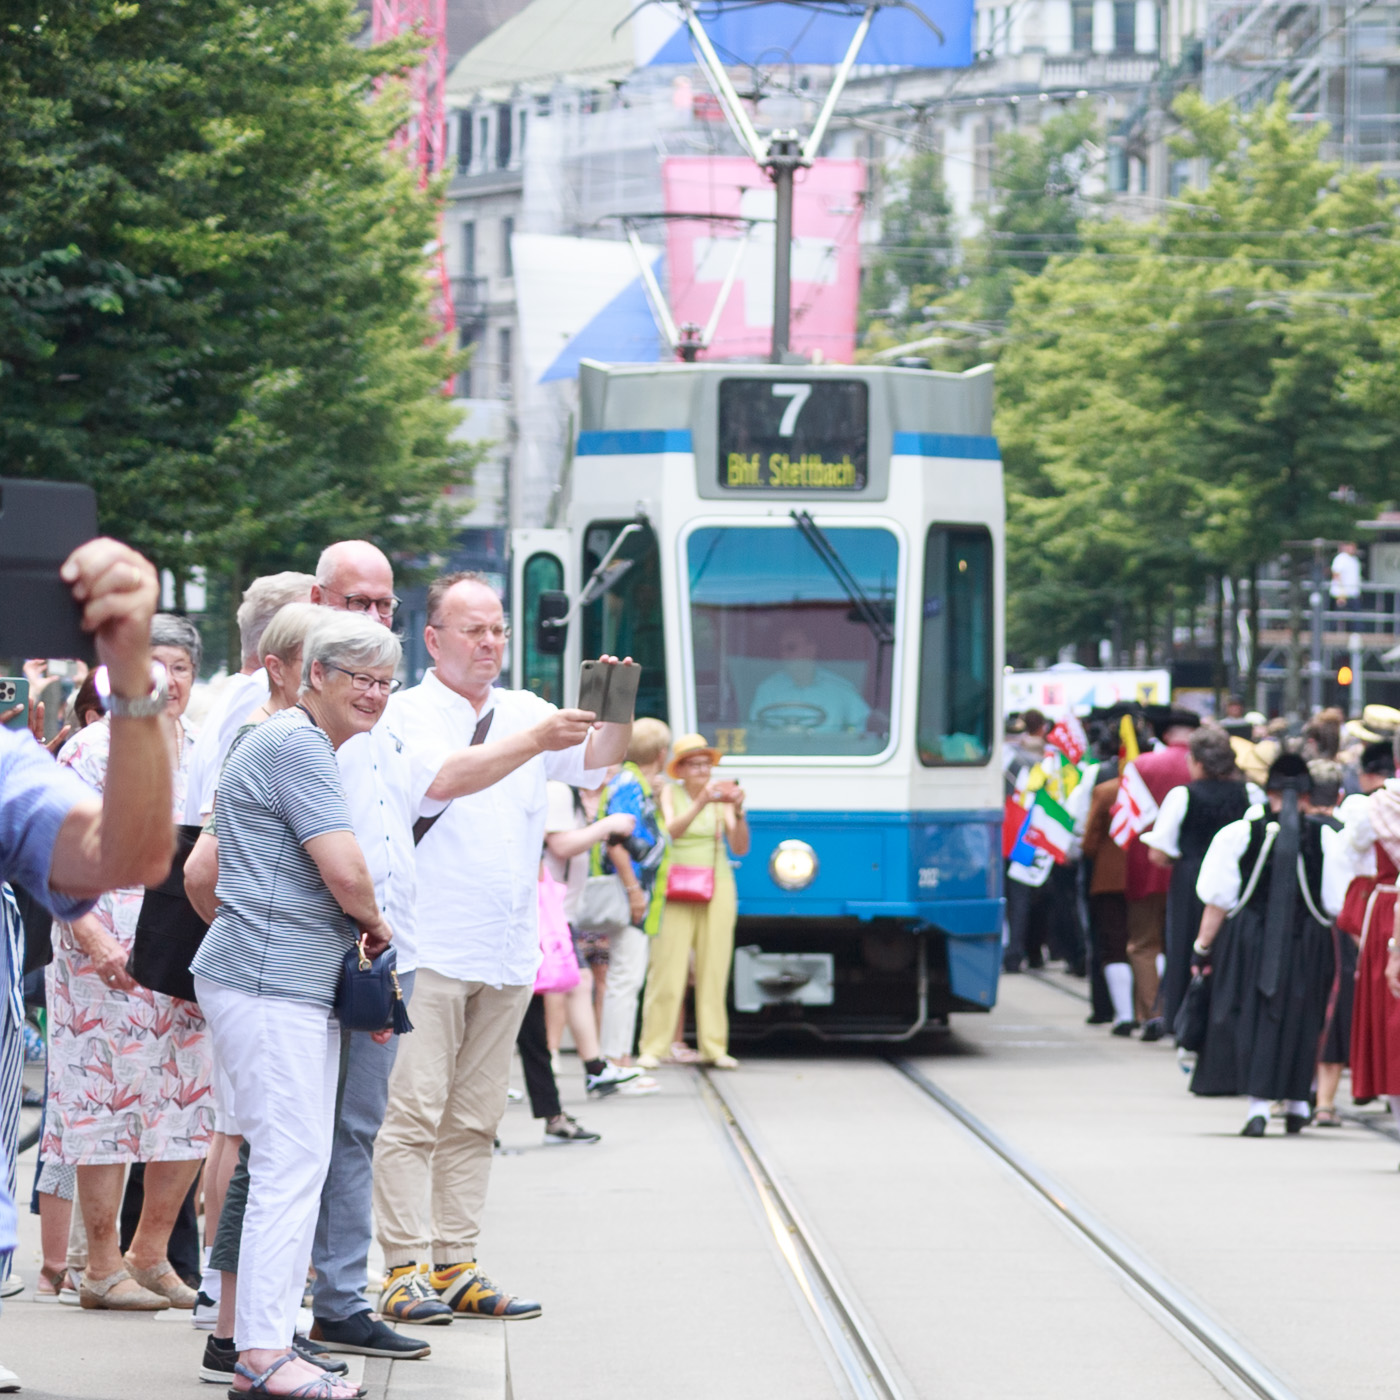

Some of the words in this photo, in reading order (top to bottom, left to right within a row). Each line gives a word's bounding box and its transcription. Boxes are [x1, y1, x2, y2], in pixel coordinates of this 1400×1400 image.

[771, 382, 812, 437] 7
[727, 452, 765, 487] Bhf.
[768, 452, 856, 487] Stettbach
